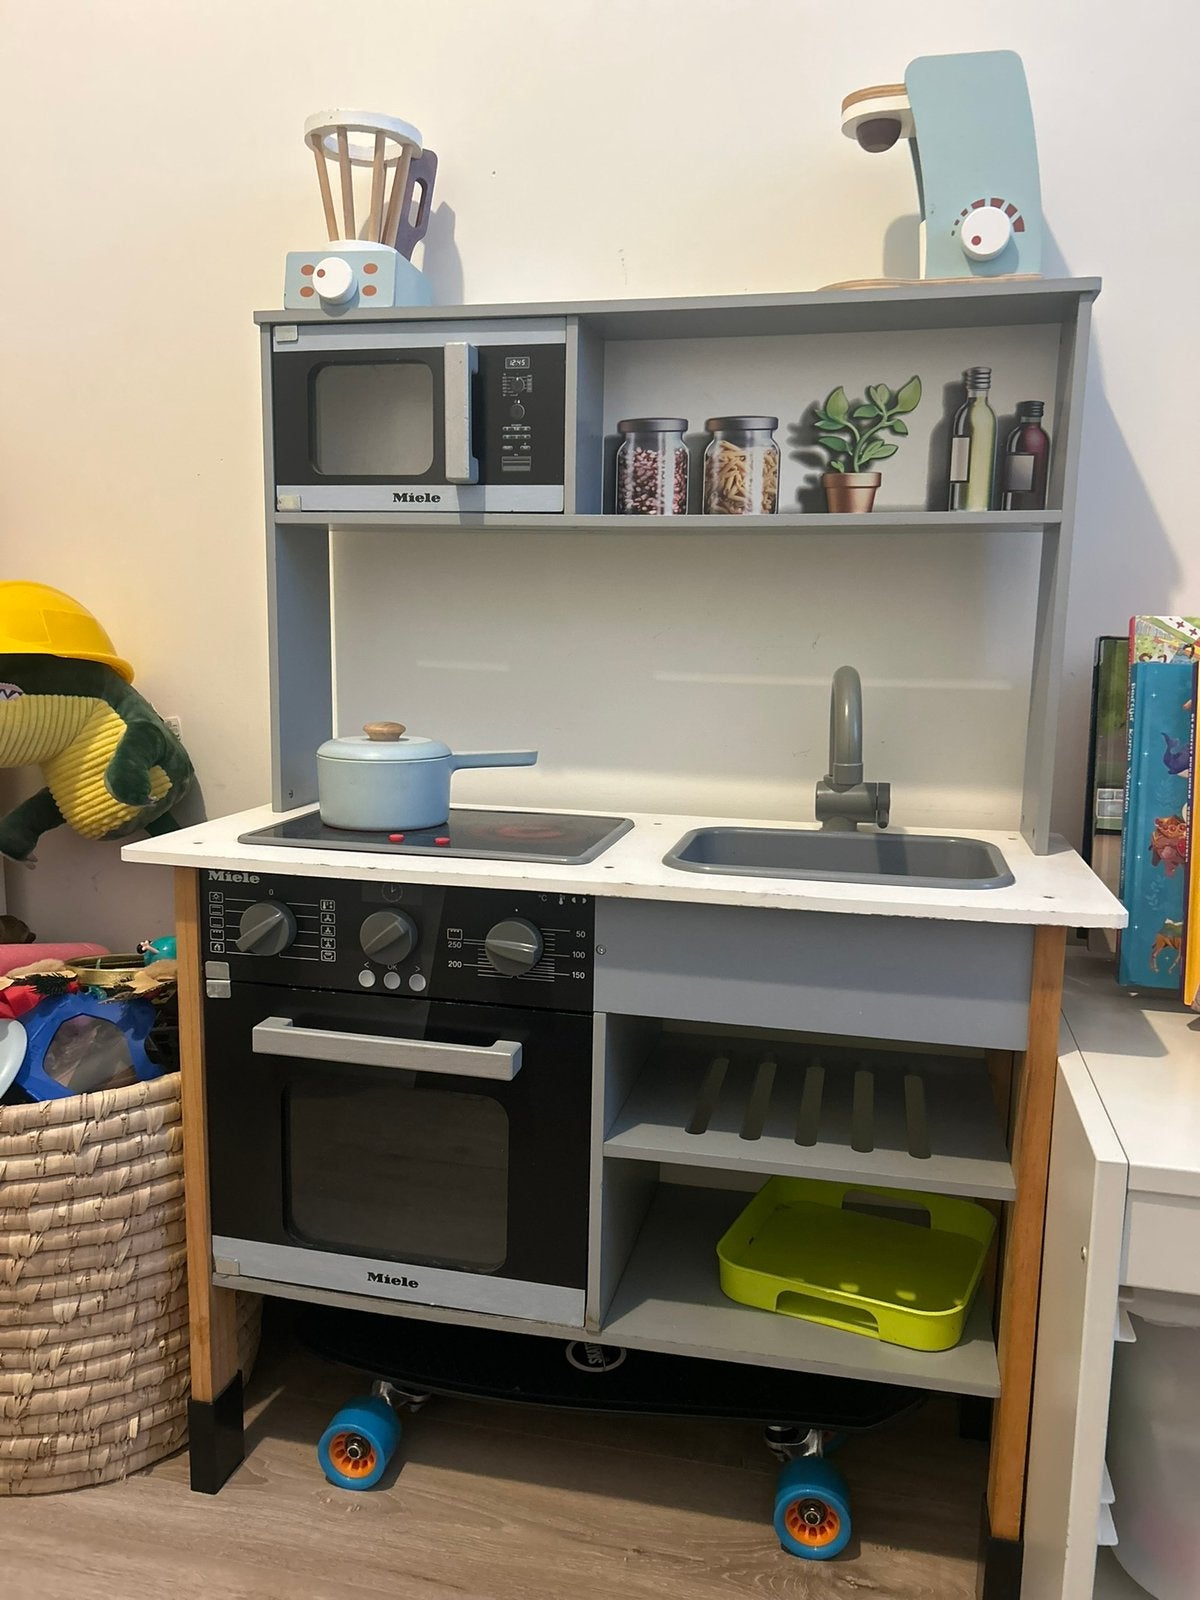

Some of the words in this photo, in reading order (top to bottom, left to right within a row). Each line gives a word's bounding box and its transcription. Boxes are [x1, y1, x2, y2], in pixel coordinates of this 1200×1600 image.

[391, 491, 442, 505] Miele
[207, 869, 261, 884] Miele
[575, 930, 586, 938] 50
[447, 941, 462, 949] 250
[572, 951, 586, 959] 100
[447, 960, 463, 968] 200
[572, 971, 586, 979] 150
[367, 1271, 419, 1288] Miele
